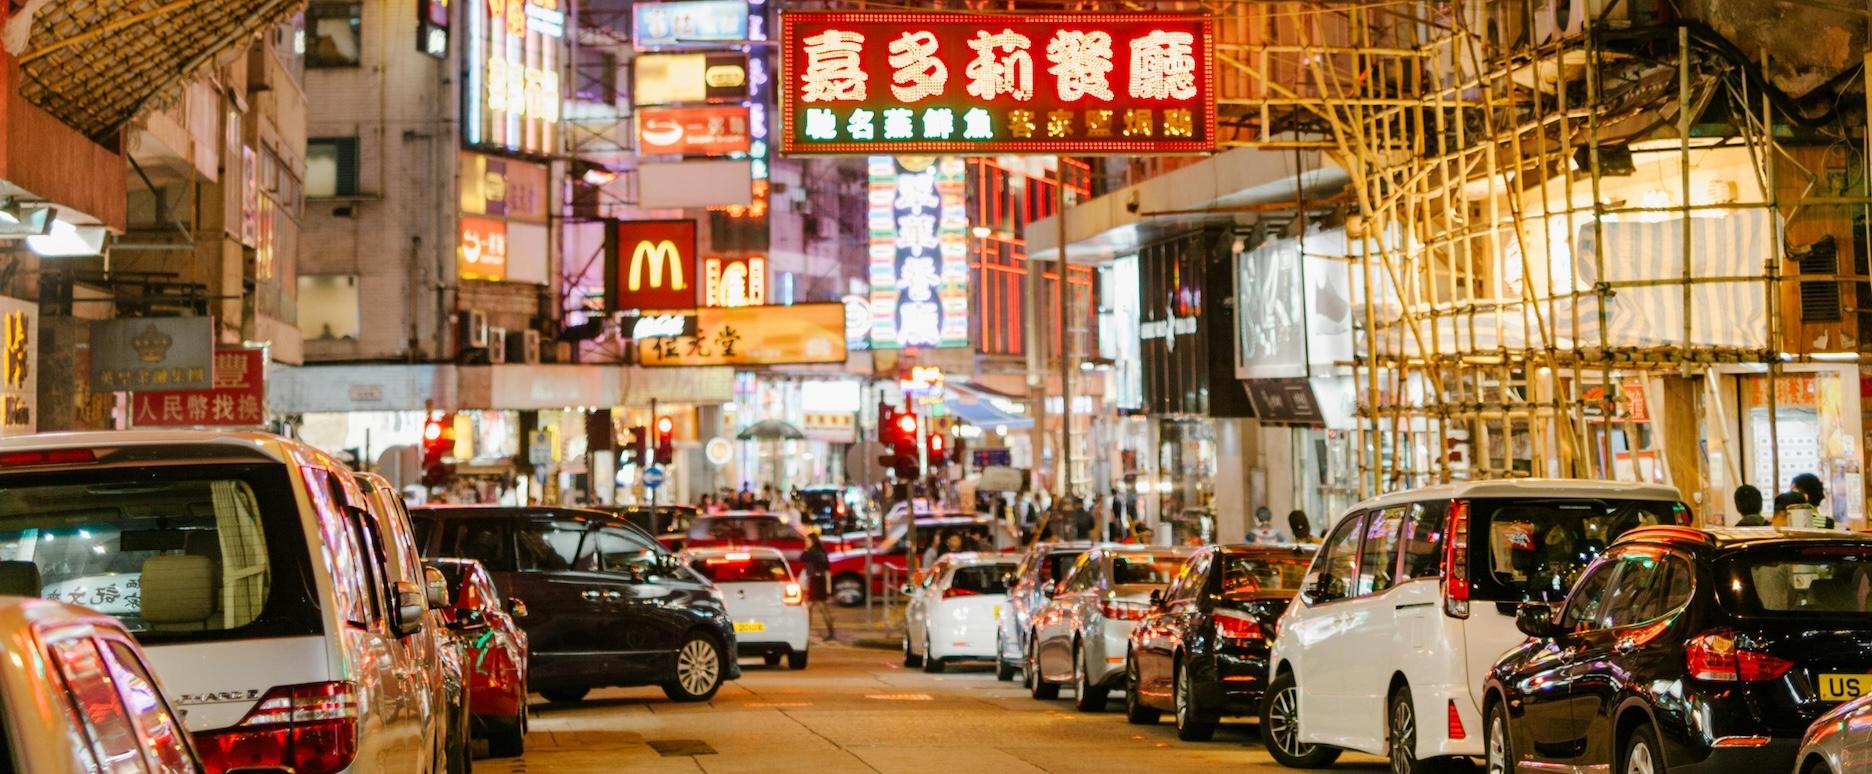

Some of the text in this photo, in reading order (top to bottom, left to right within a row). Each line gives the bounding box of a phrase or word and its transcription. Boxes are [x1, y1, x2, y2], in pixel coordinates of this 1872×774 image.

[801, 29, 1198, 103] 嘉多莉餐廳
[652, 325, 741, 360] 位元堂
[214, 354, 250, 388] 豐
[137, 393, 260, 421] 人民幣找換
[1829, 678, 1860, 697] US
